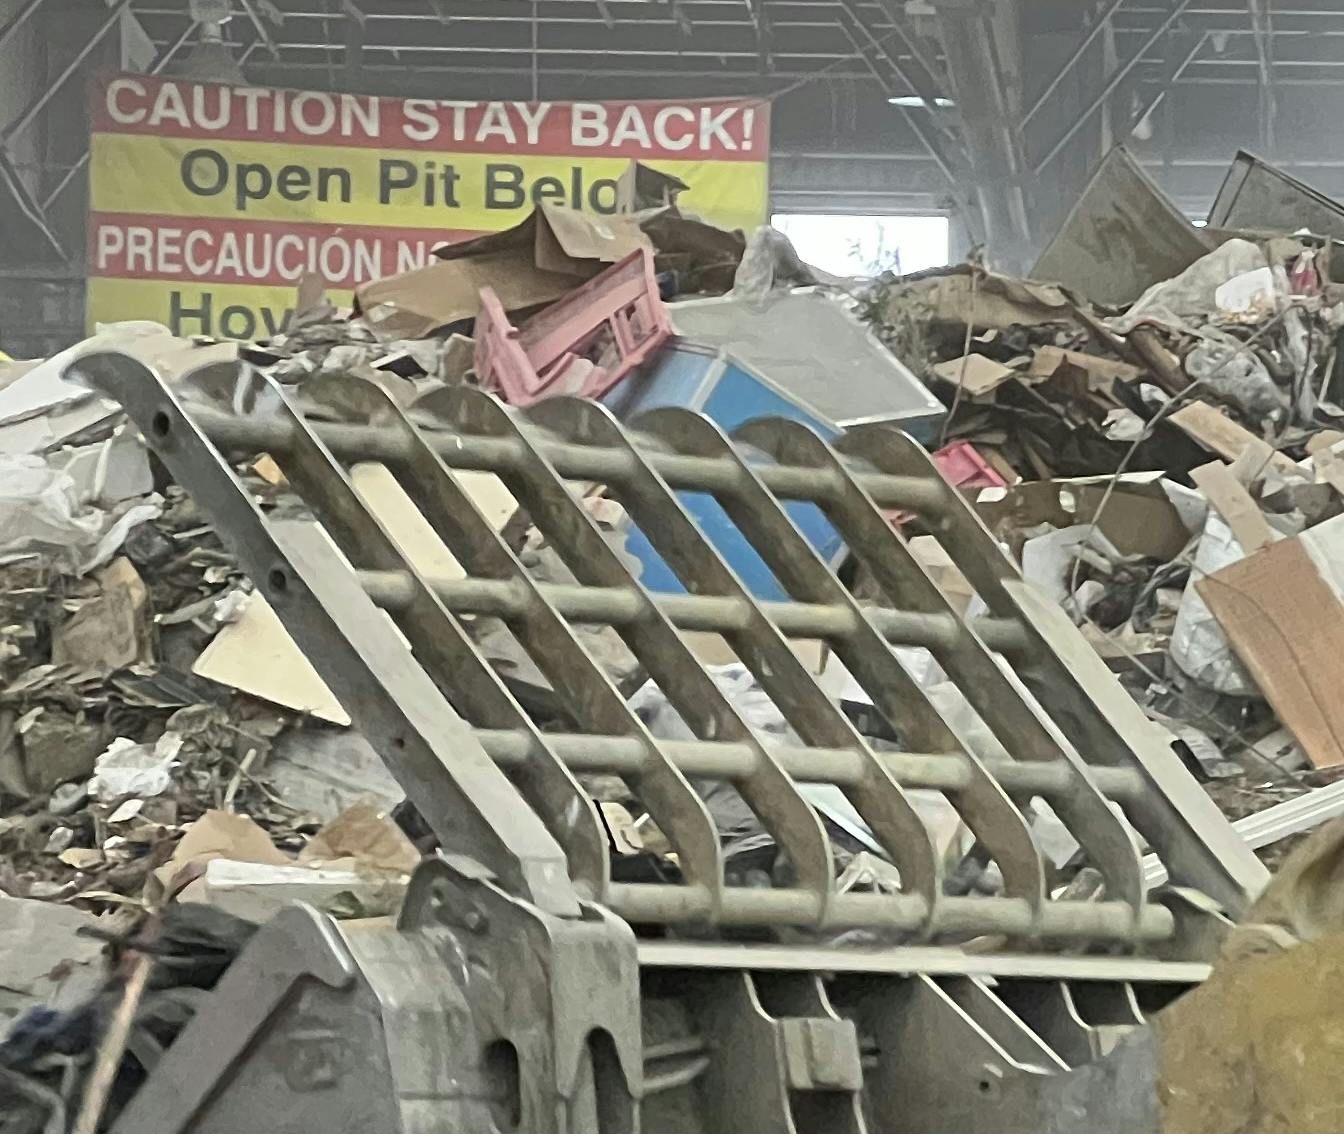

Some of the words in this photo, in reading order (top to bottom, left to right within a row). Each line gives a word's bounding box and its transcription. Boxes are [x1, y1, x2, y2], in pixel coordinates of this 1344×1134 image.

[105, 78, 379, 138] CAUTION
[402, 99, 561, 146] STAY
[571, 101, 755, 152] BACK!
[180, 148, 351, 210] Open
[378, 158, 461, 208] Pit
[484, 163, 619, 215] Belo
[97, 224, 382, 283] PRECAUCIÓN
